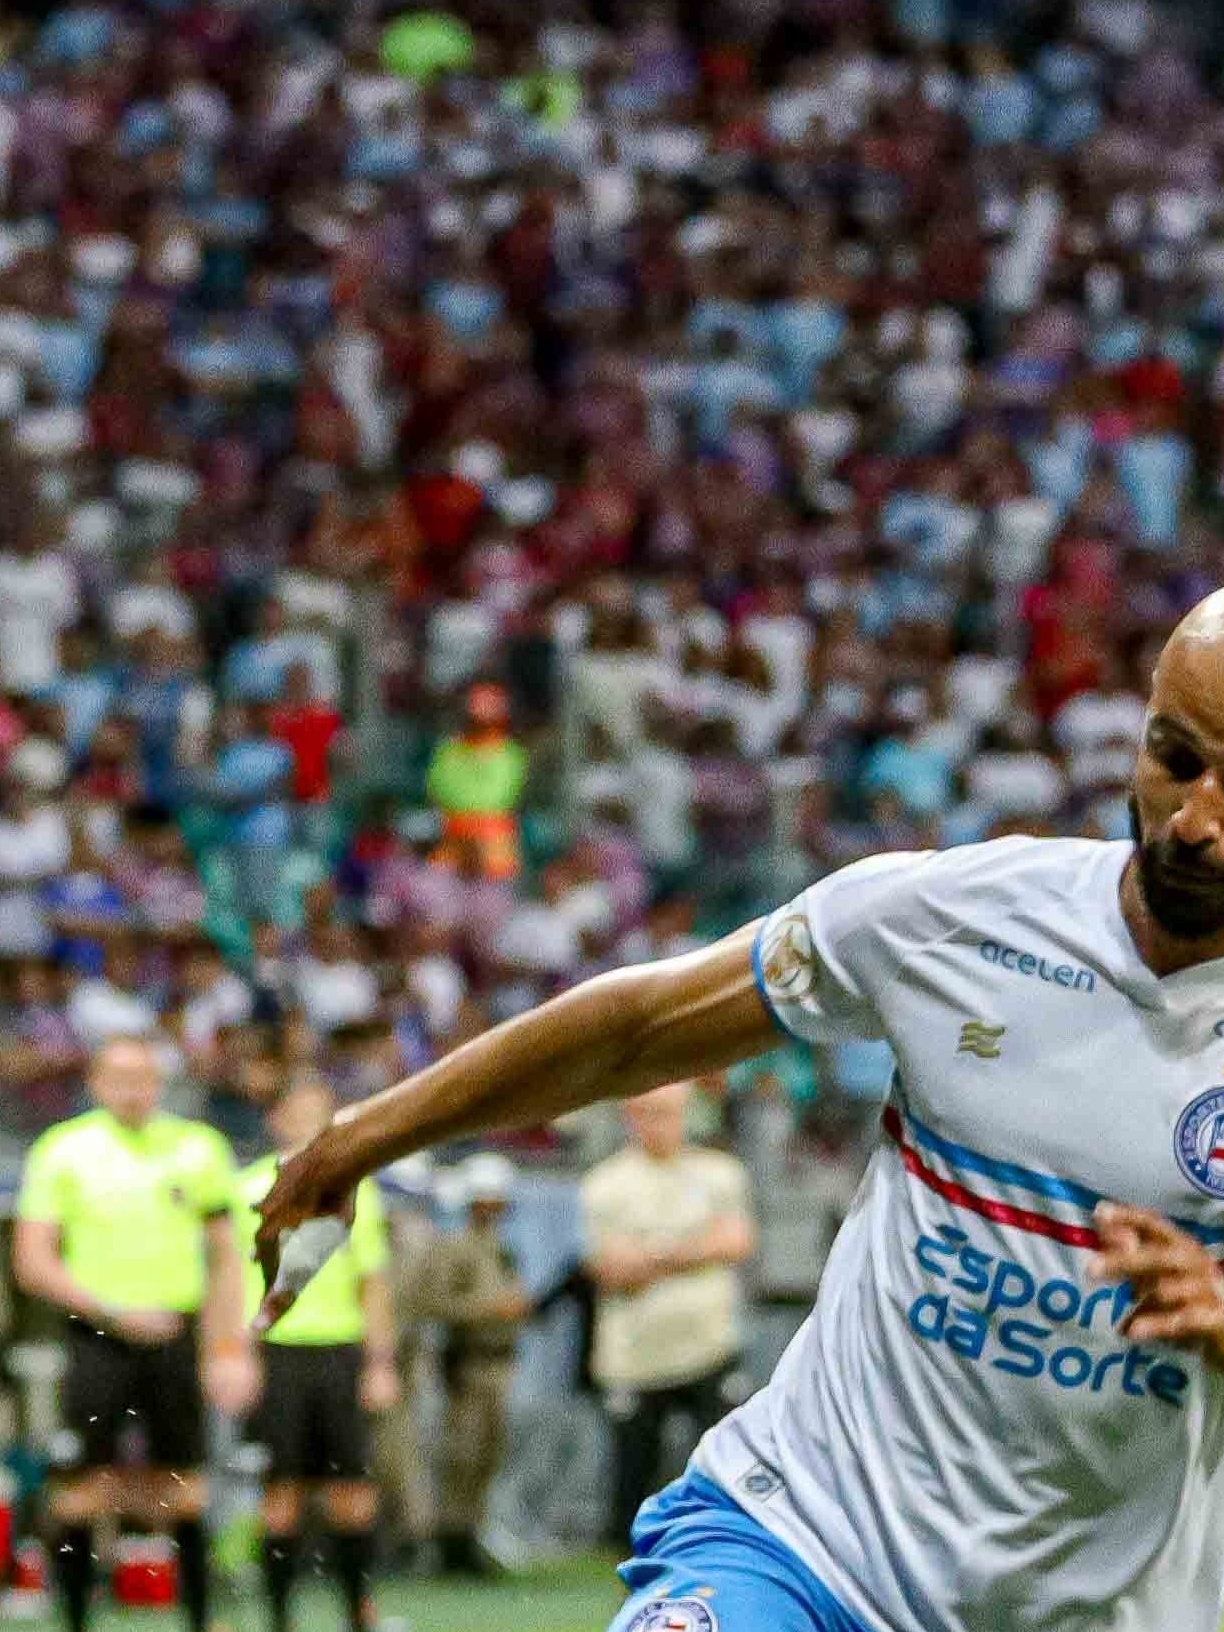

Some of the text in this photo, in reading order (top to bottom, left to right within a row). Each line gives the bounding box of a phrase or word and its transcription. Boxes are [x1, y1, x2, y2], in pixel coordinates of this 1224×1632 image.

[978, 938, 1097, 994] acelen
[914, 1223, 1135, 1328] Esport
[908, 1292, 1190, 1407] da Sorte
